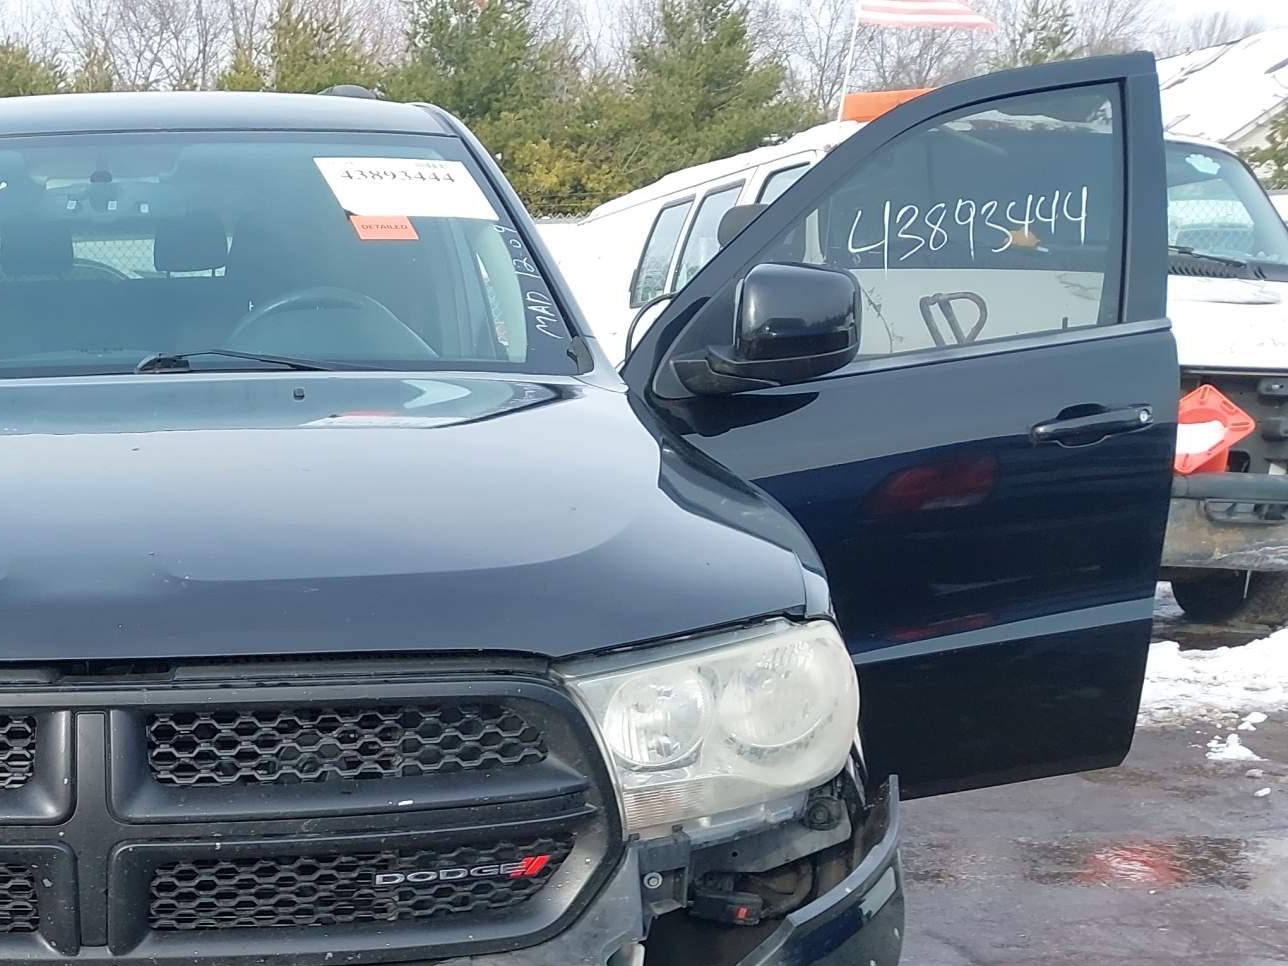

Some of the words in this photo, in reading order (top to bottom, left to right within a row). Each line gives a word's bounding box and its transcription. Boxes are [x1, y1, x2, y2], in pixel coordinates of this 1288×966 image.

[340, 169, 456, 183] 43893444
[360, 223, 409, 231] DETAILED
[847, 185, 1089, 280] 43893444
[375, 860, 528, 886] DODGE
